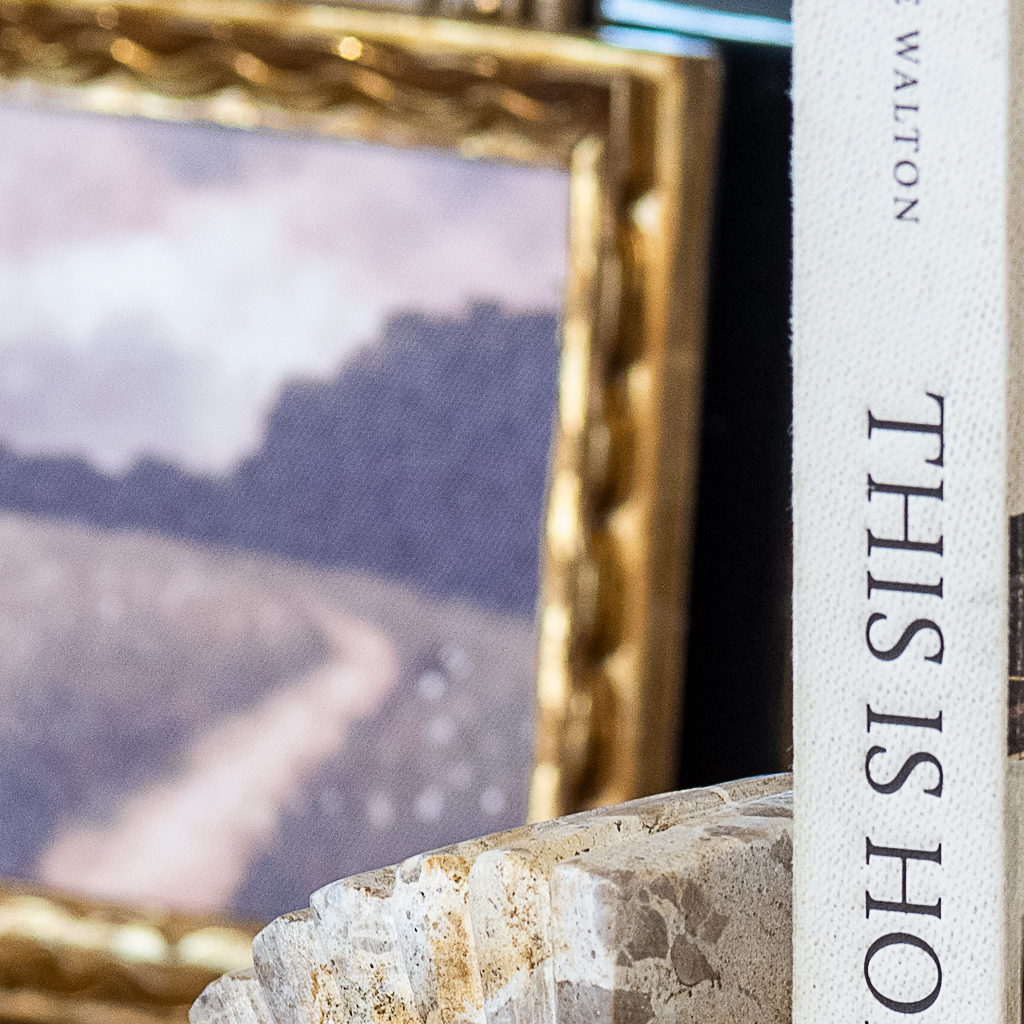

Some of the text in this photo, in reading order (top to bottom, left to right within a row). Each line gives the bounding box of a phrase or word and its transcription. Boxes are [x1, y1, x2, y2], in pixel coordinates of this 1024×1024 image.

[893, 30, 920, 224] WALTON
[865, 391, 945, 665] THIS
[864, 703, 944, 799] IS
